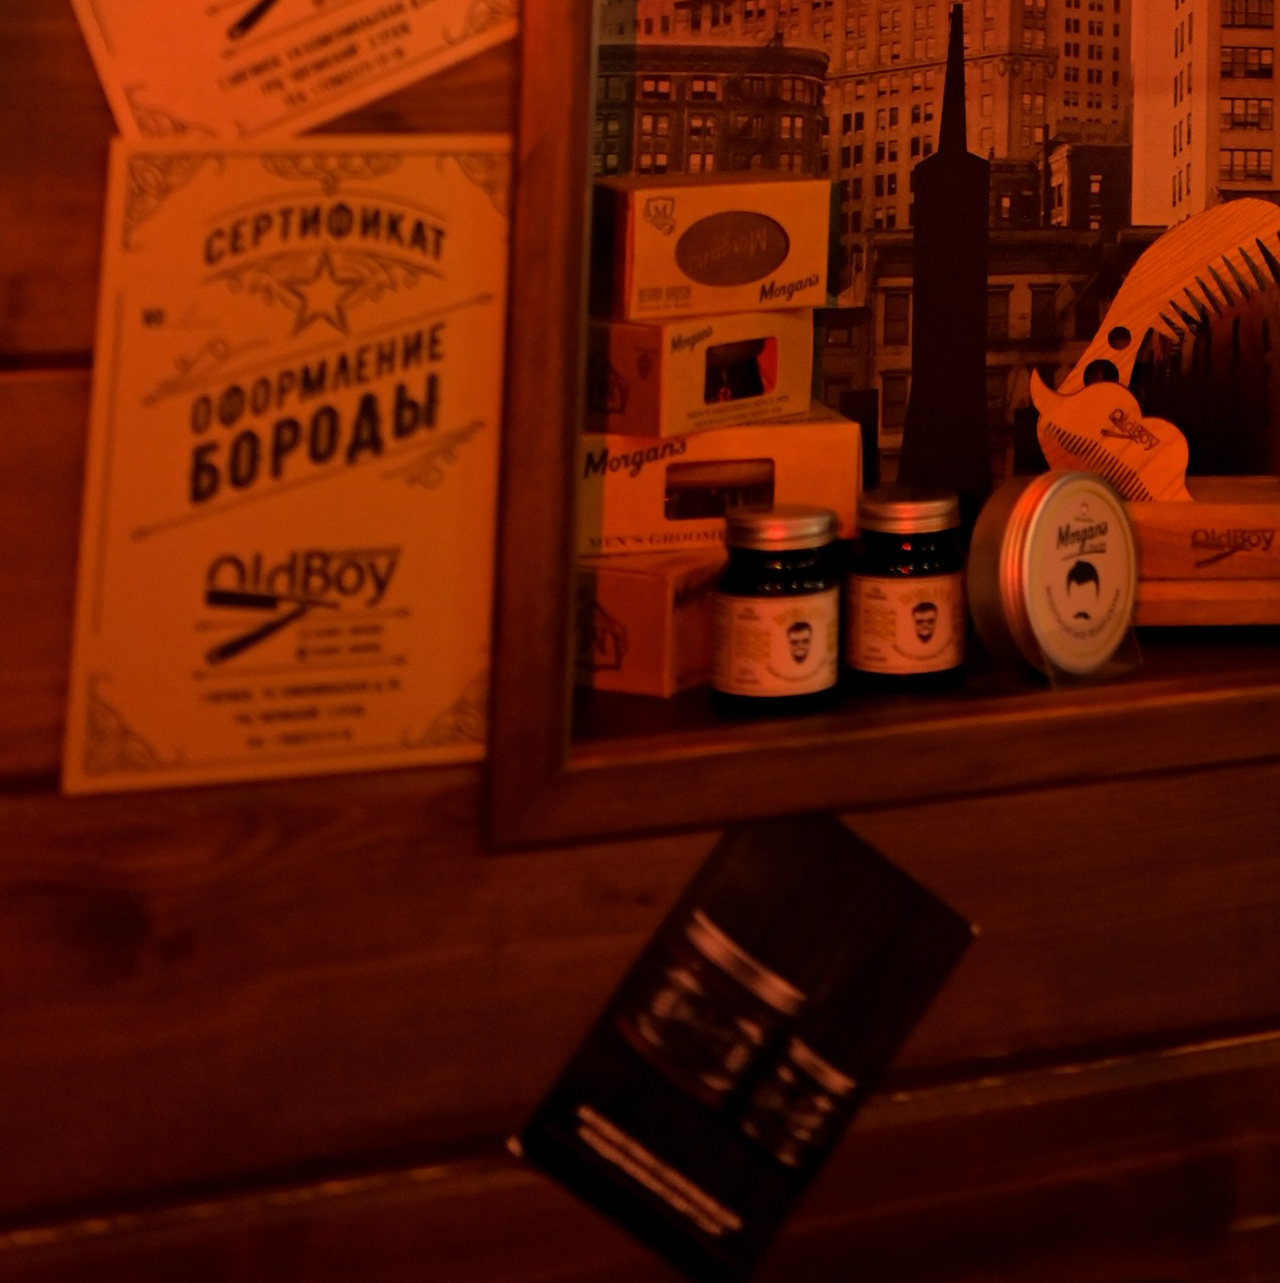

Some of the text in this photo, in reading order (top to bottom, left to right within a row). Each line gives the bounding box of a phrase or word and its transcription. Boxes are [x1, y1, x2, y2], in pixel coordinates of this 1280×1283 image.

[205, 201, 448, 267] СЕРТИФИКАТ
[759, 272, 820, 304] Morgan's
[190, 322, 448, 436] ОФОРМЛЕНИЕ
[189, 372, 442, 505] БОРОДЫ
[584, 438, 687, 480] Morgan's
[1056, 520, 1108, 553] Morgan's
[206, 547, 401, 607] OldBoy
